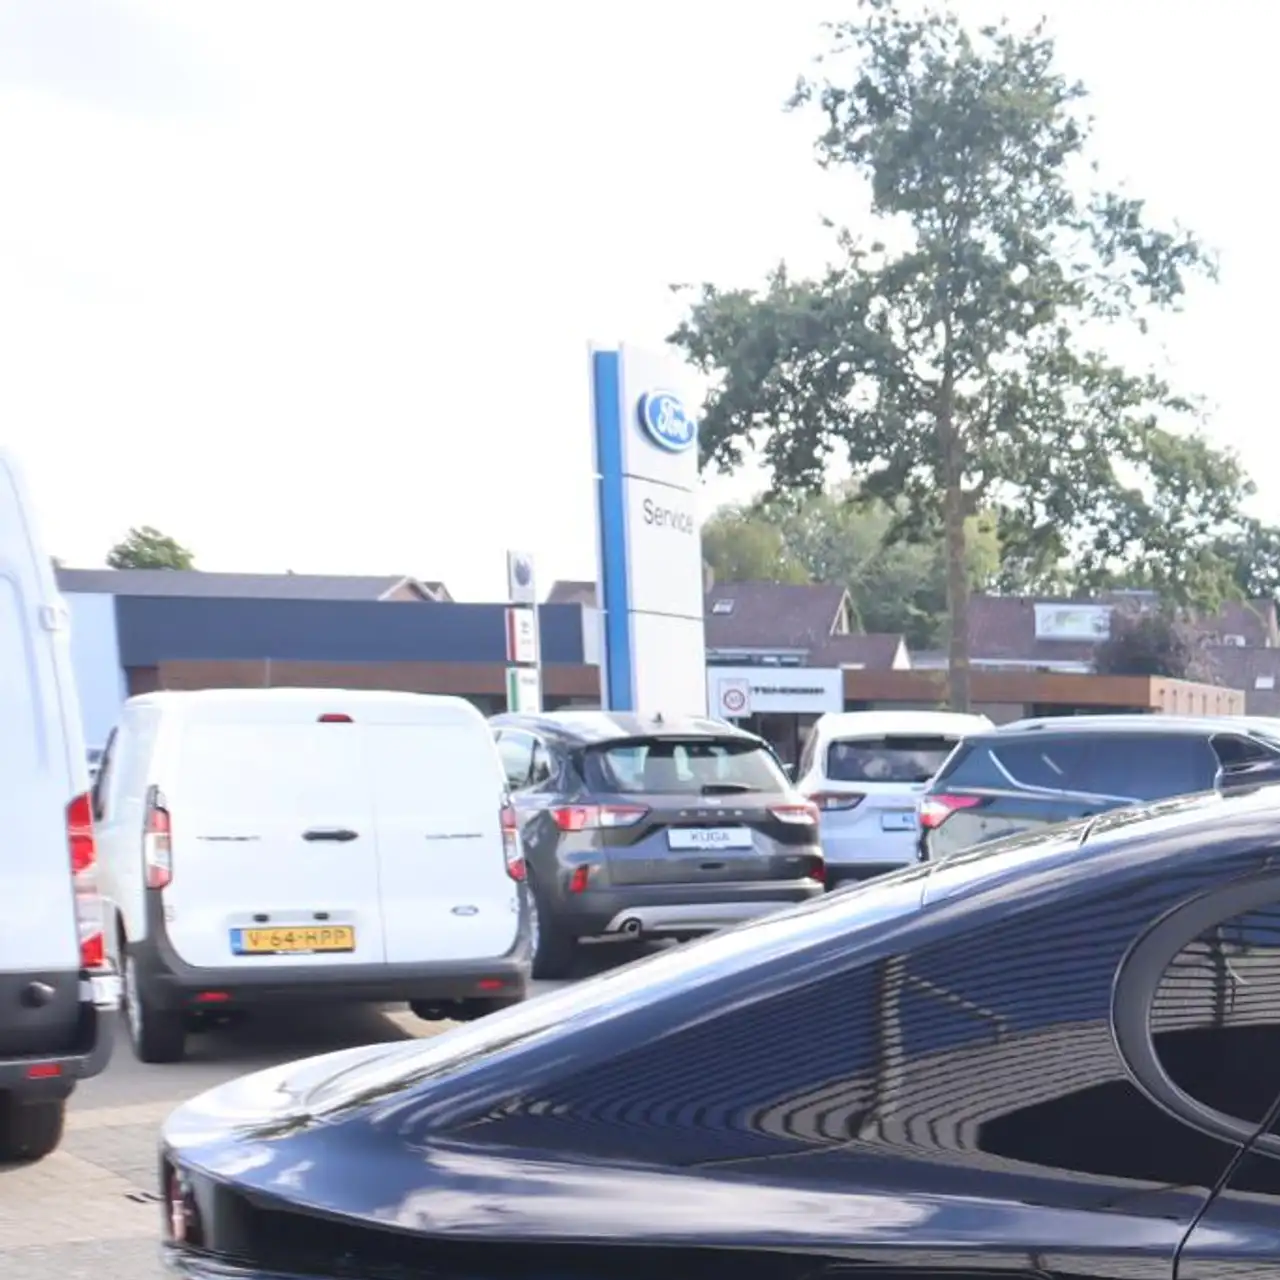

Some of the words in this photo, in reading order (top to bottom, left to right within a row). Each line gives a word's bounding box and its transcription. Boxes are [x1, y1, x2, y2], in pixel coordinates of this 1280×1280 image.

[643, 498, 694, 535] Service
[690, 831, 730, 842] KUGA
[247, 930, 347, 949] V-64-HPP
